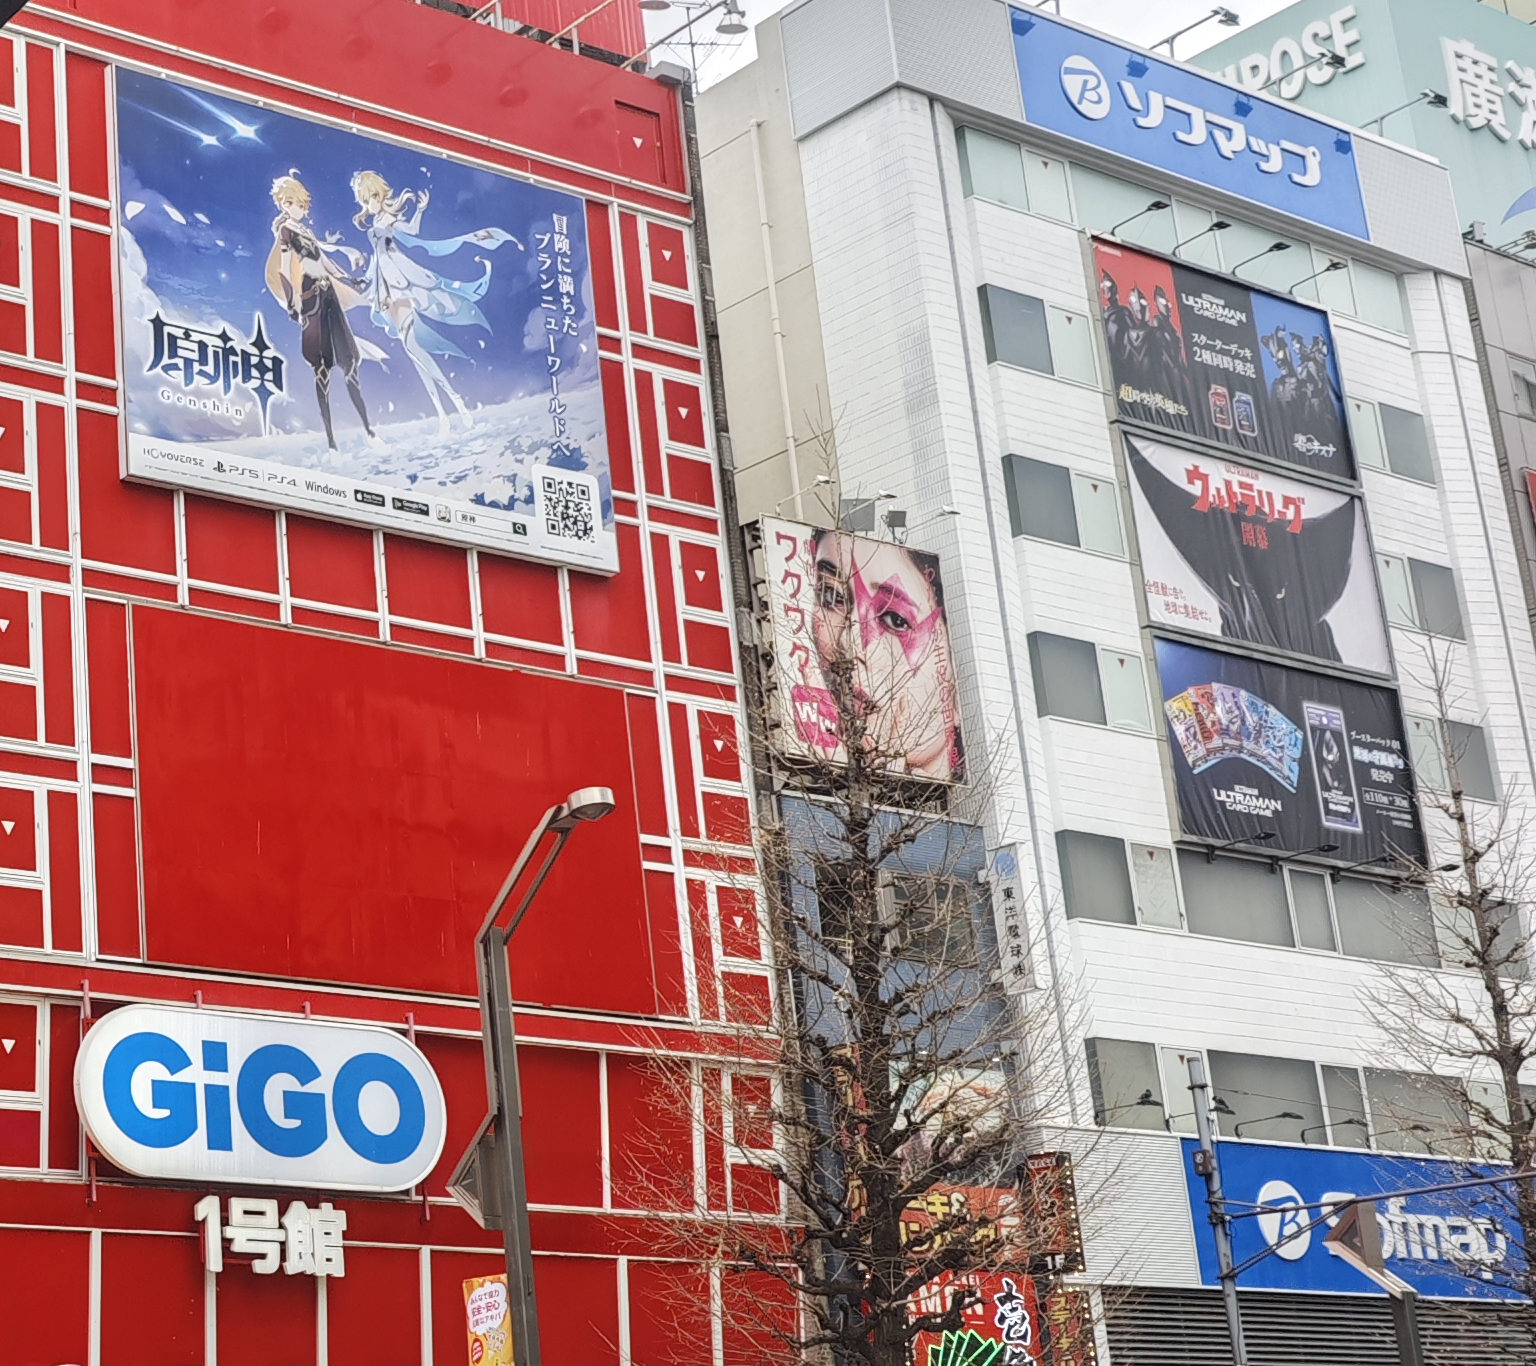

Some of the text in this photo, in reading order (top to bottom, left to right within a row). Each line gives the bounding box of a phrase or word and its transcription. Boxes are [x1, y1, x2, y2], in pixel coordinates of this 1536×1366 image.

[1216, 5, 1365, 99] ROSE
[1117, 80, 1321, 187] ソフマップ
[553, 213, 579, 336] 冒険に満ちた
[1181, 293, 1247, 324] ULTRAMAN
[535, 234, 571, 457] ブランニューワールドへ
[1191, 333, 1253, 360] スターターデッキ
[1194, 307, 1239, 327] CARD GAME
[146, 311, 285, 436] 原神
[1192, 346, 1257, 379] 2種同時発売
[160, 389, 243, 417] Genshin
[229, 465, 260, 479] PS5
[267, 473, 298, 487] PS4
[305, 480, 348, 499] Windows
[1184, 463, 1305, 534] ウルトラリーグ
[775, 531, 811, 673] ワクワク
[1212, 787, 1282, 812] ULTRAMAN
[1226, 802, 1273, 817] CARD GAME
[102, 1030, 426, 1166] GiGO
[194, 1195, 348, 1278] 1号館
